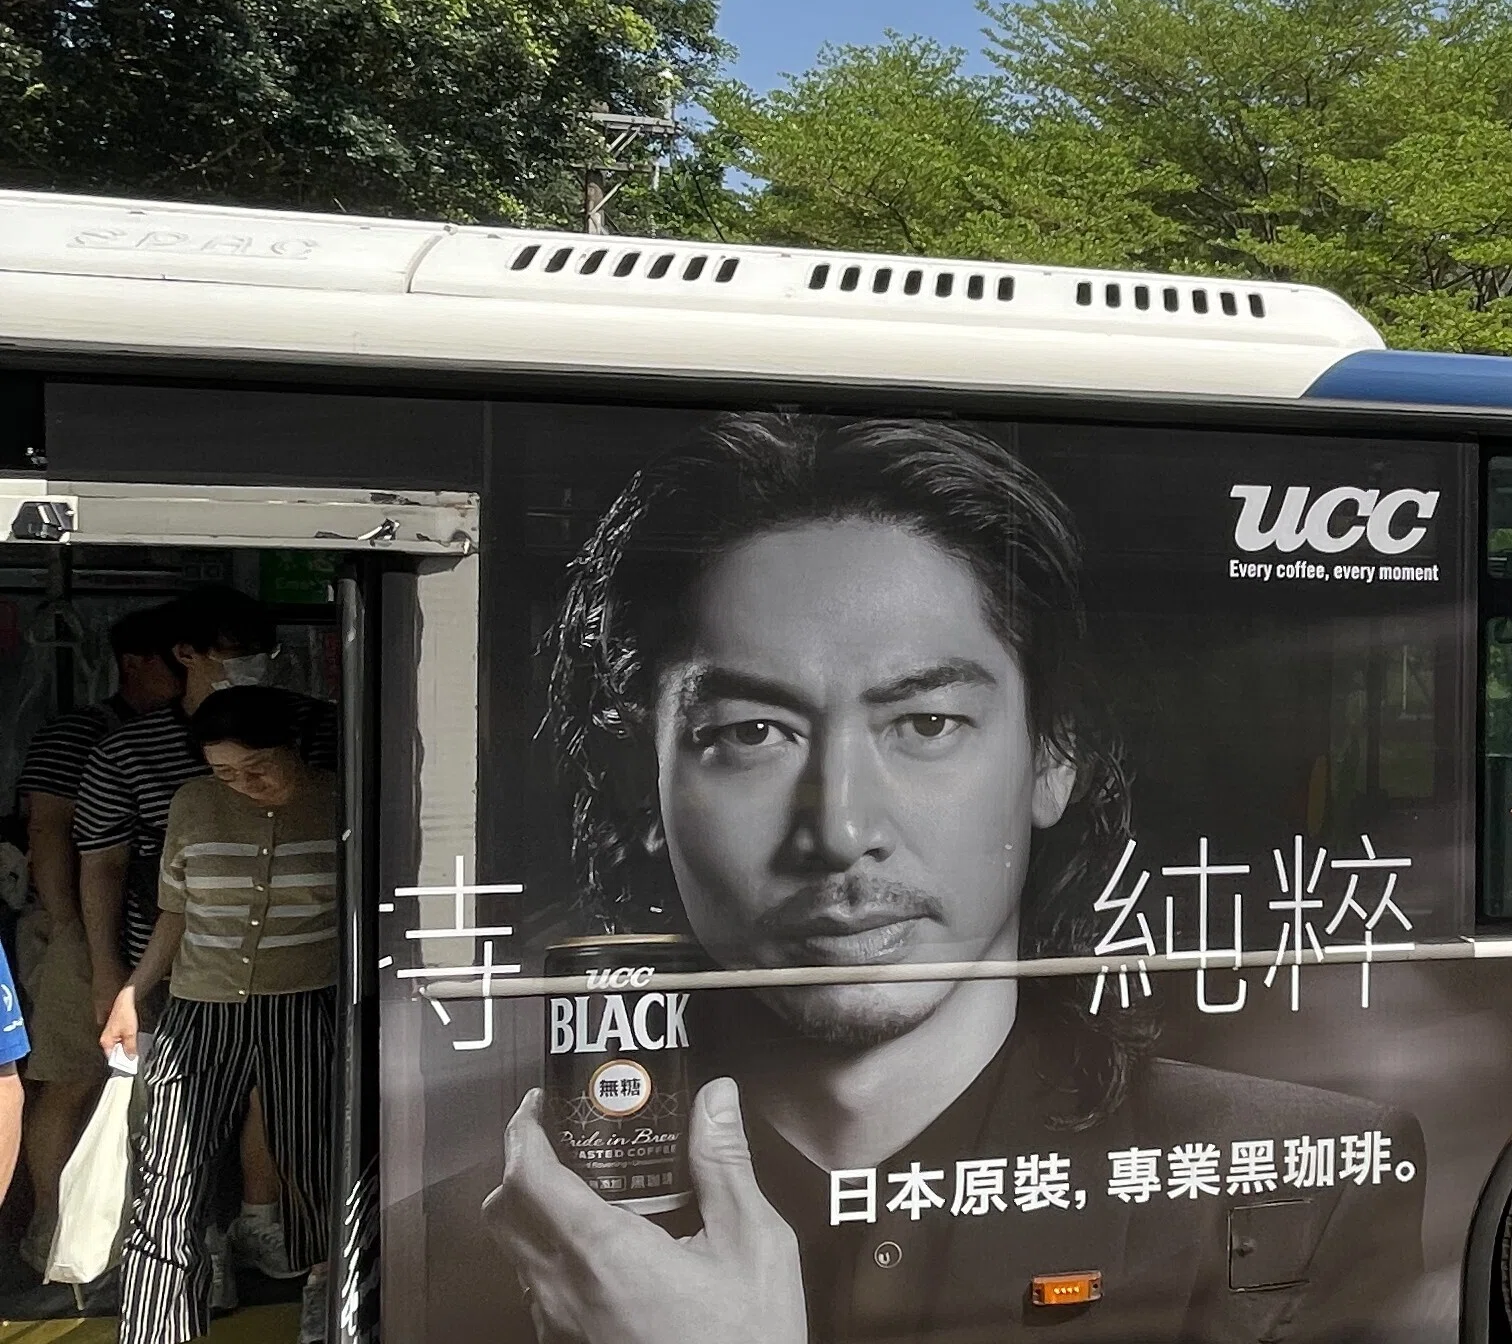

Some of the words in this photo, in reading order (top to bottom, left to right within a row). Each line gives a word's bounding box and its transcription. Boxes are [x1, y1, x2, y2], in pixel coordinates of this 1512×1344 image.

[1229, 559, 1273, 581] Every
[1276, 560, 1330, 582] coffee,
[1333, 565, 1376, 583] every
[1379, 564, 1440, 582] moment
[550, 992, 691, 1055] BLACK
[599, 1077, 642, 1098] 無糖
[560, 1130, 605, 1148] Pride
[606, 1132, 630, 1146] in
